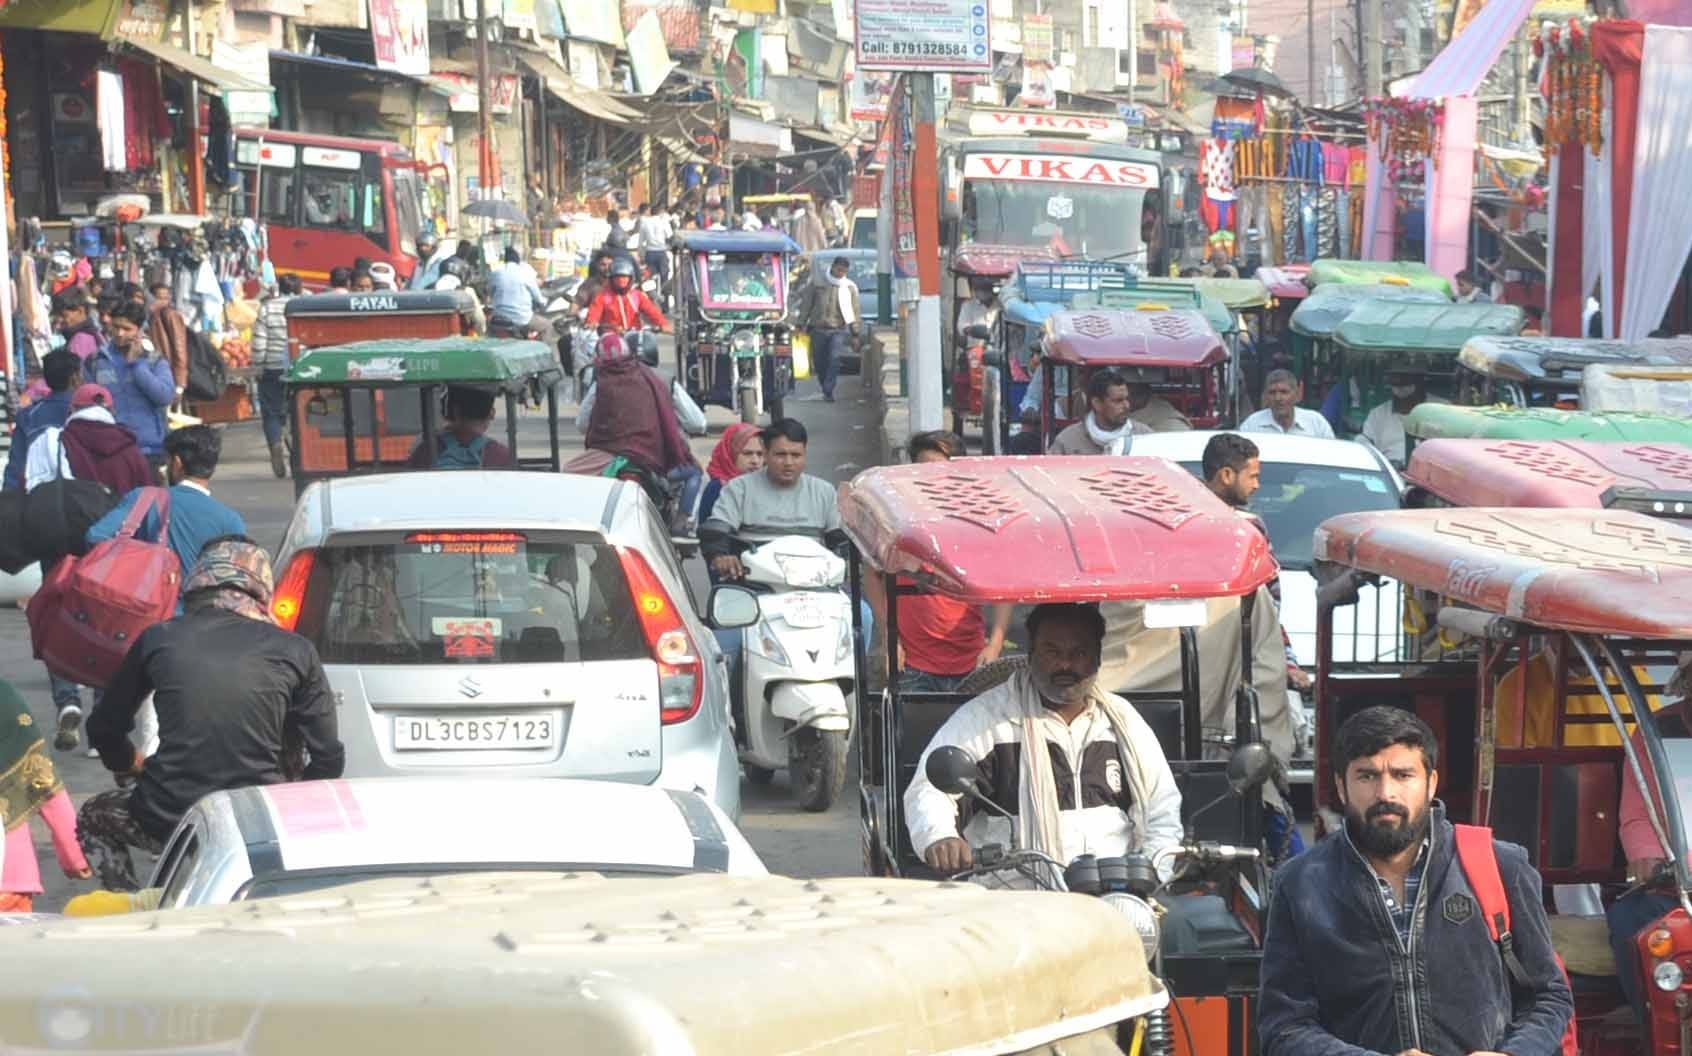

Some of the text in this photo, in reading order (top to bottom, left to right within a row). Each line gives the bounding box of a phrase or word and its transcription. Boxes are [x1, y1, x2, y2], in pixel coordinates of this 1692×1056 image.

[861, 41, 889, 54] Call:
[992, 113, 1110, 129] VIKAS
[979, 157, 1148, 185] VIKAS
[350, 296, 398, 310] PAYAL
[410, 720, 550, 742] DL3CBS7123
